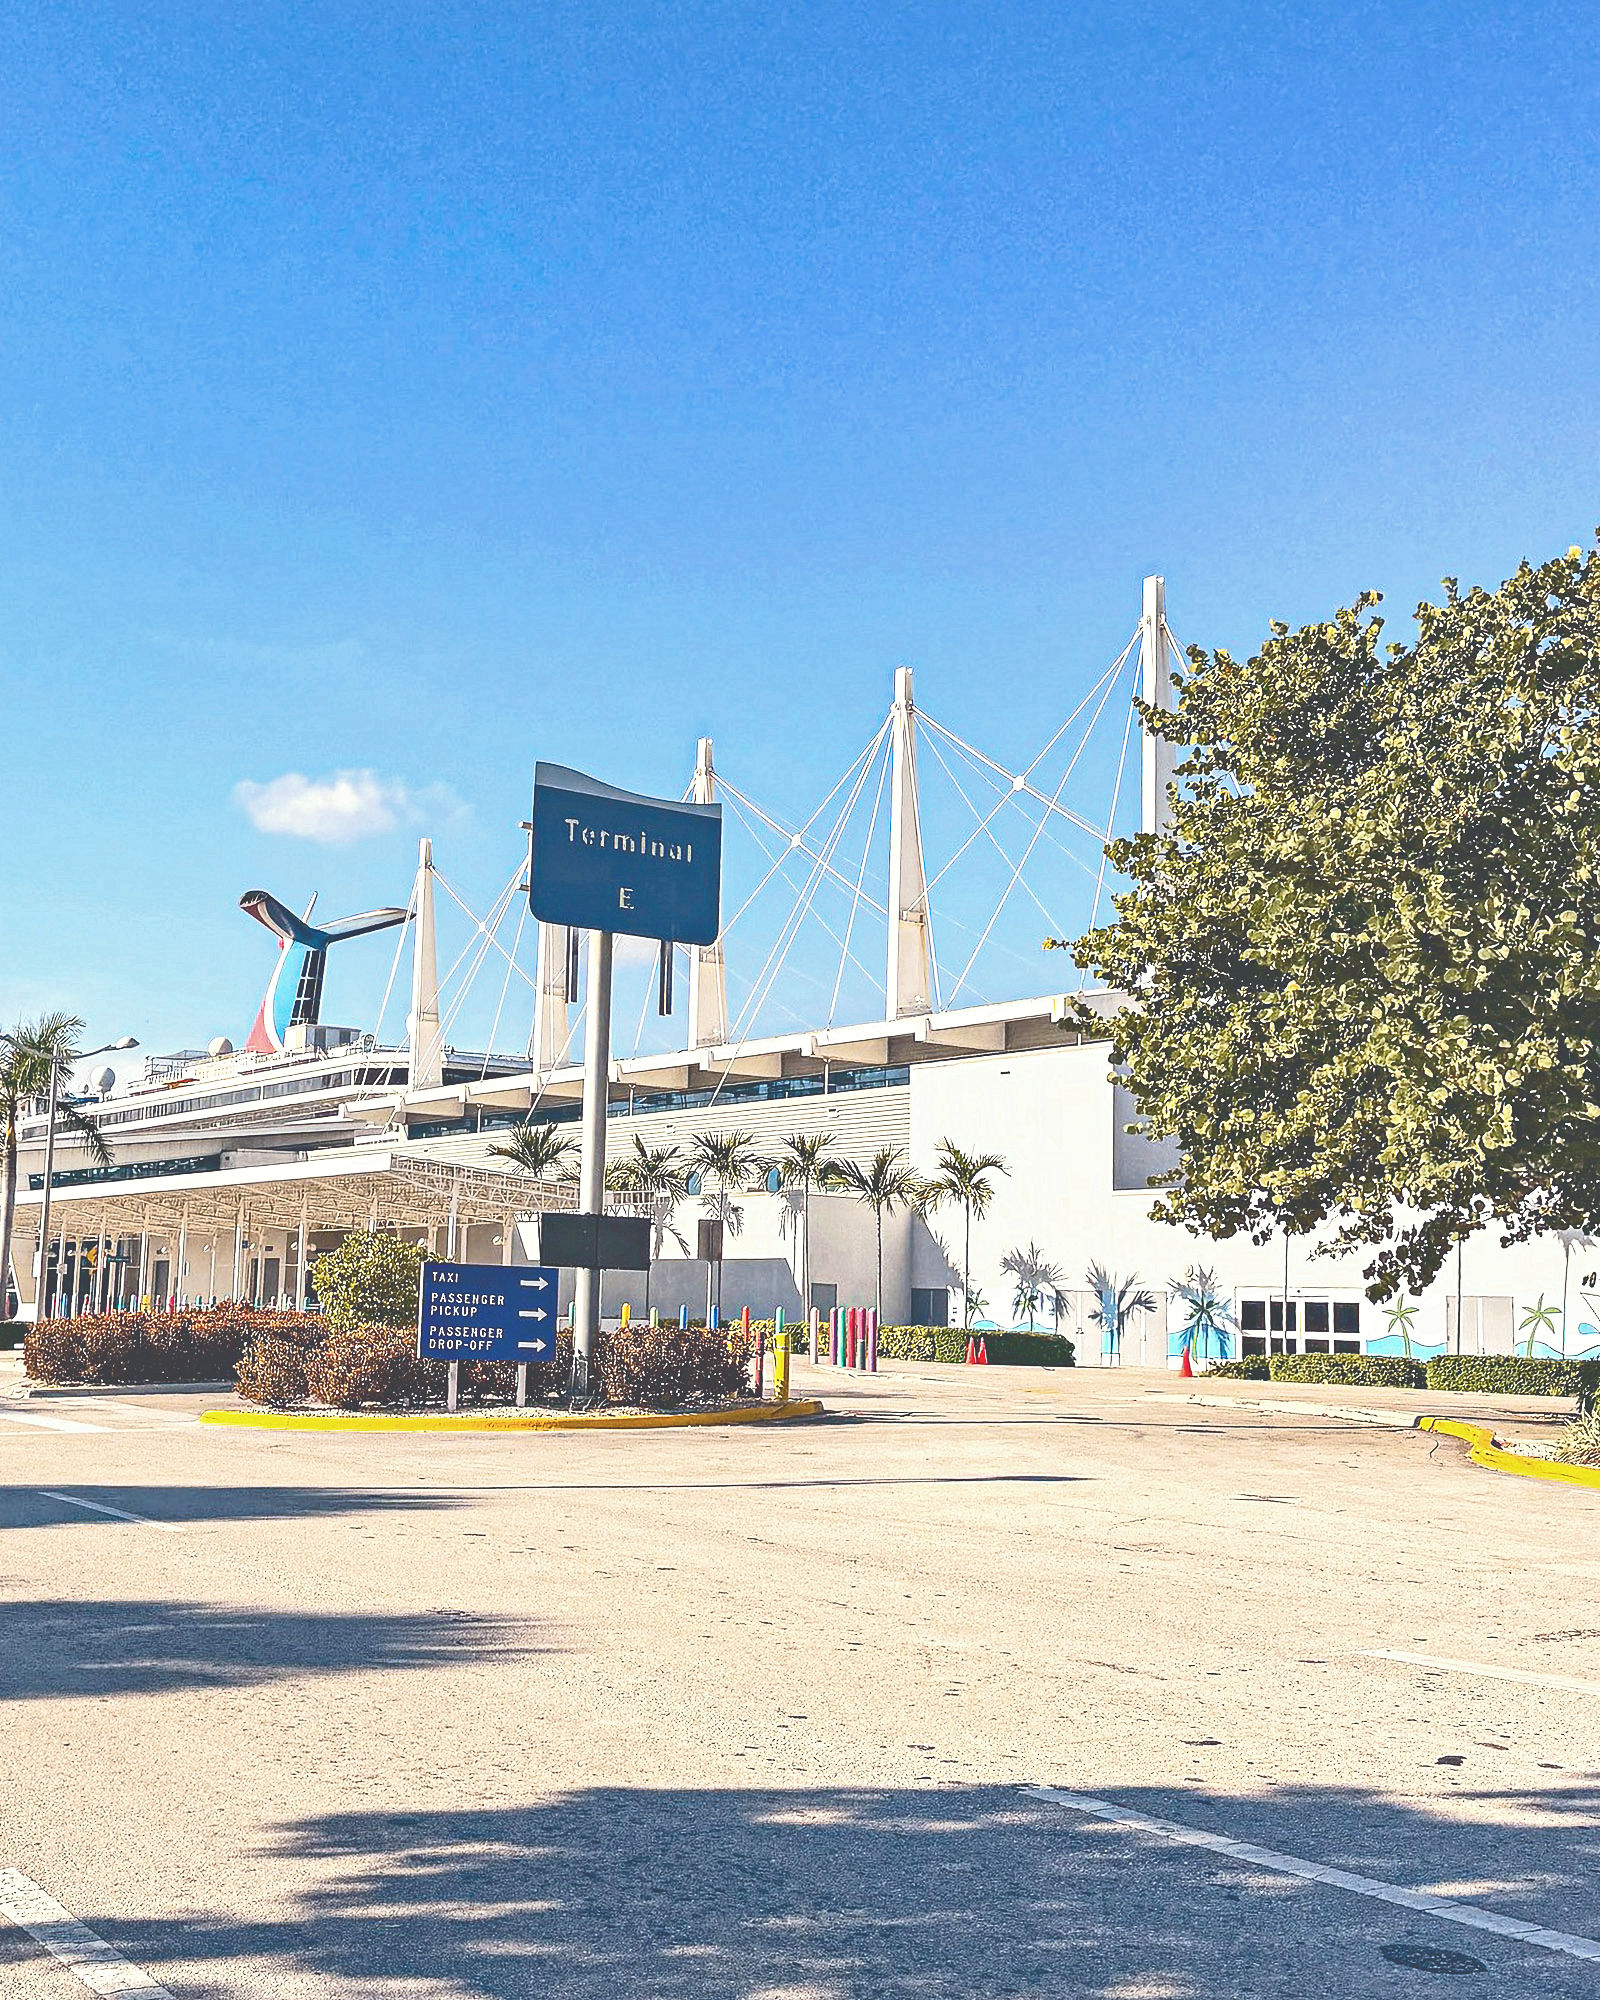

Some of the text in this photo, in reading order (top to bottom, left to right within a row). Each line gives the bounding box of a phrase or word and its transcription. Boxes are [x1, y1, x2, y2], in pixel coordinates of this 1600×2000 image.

[565, 818, 693, 863] Terminal
[618, 886, 635, 909] E
[431, 1271, 459, 1283] TAXI
[430, 1292, 505, 1306] PASSENGER
[430, 1305, 478, 1317] PICKUP
[429, 1325, 504, 1339] PASSENGER
[428, 1338, 493, 1351] DROP-OFF
